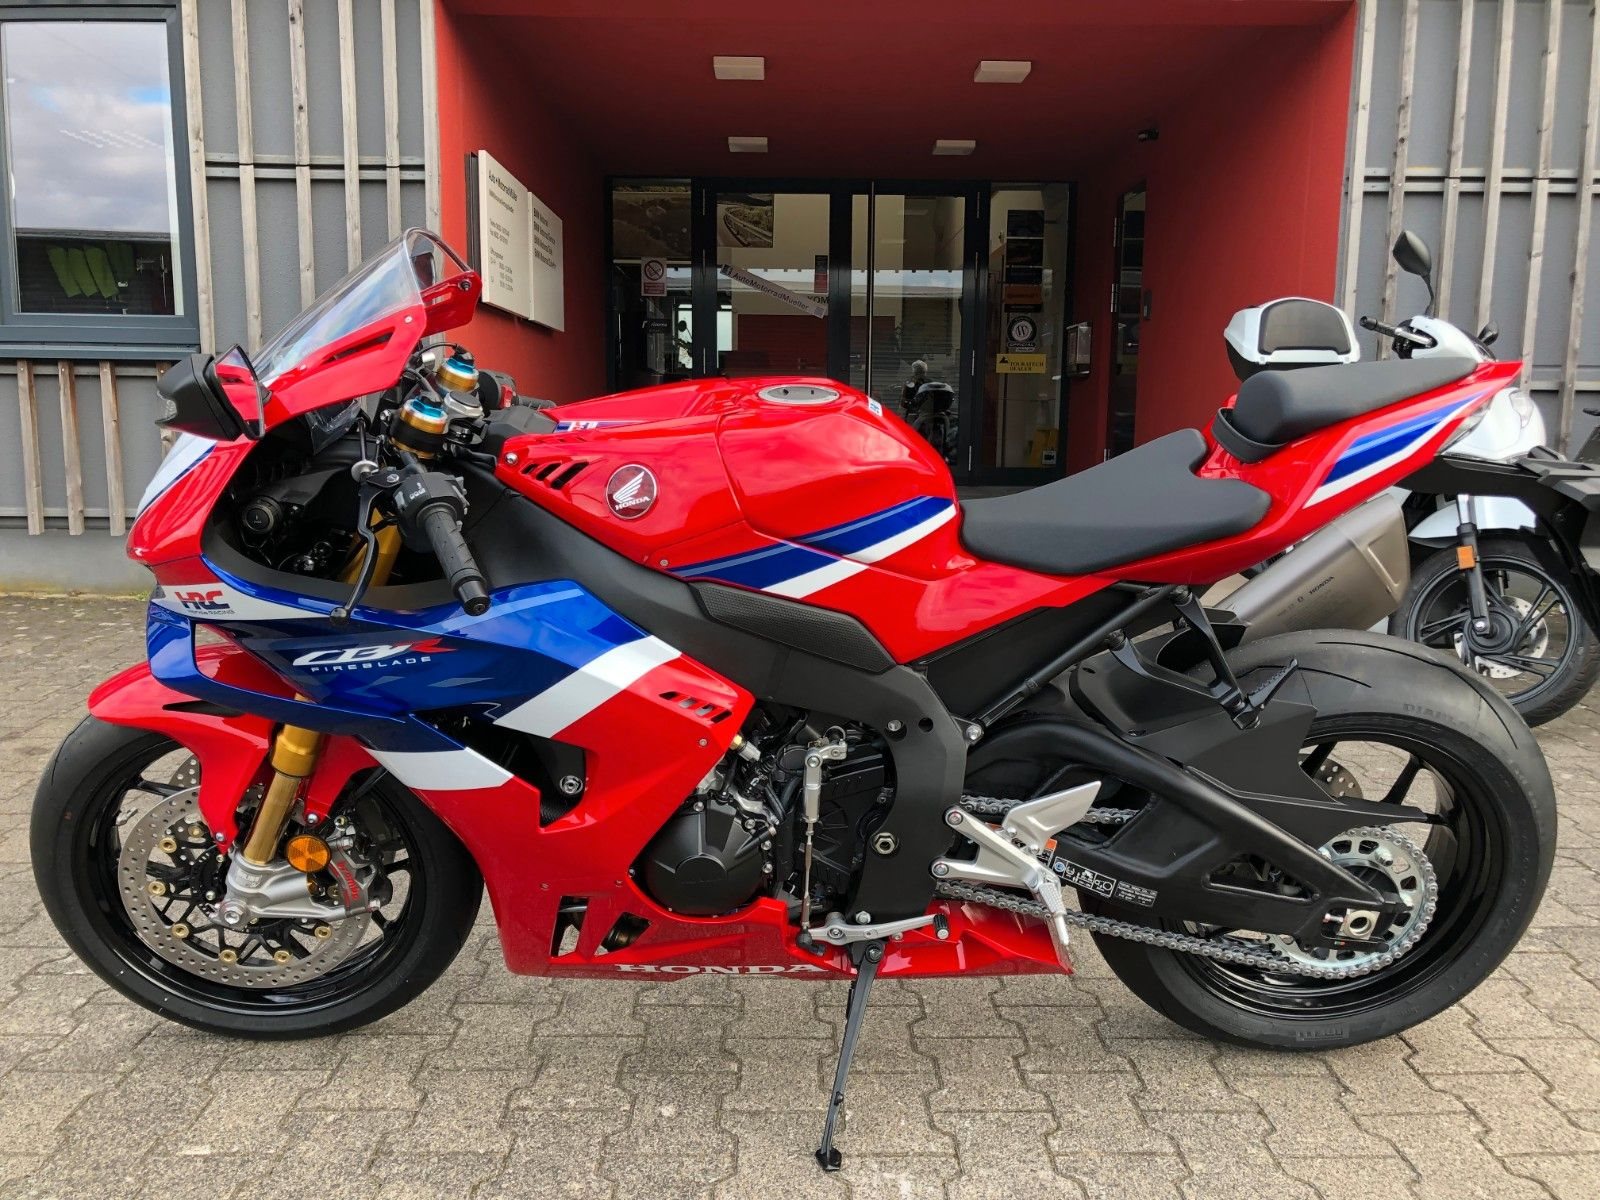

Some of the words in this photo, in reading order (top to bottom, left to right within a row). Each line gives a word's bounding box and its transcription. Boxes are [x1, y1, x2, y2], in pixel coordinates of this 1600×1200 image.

[615, 496, 651, 511] HONDA
[1309, 576, 1335, 595] HONDA
[174, 590, 230, 610] HRC
[311, 655, 432, 673] FIREBLADE
[614, 964, 829, 975] HONDA
